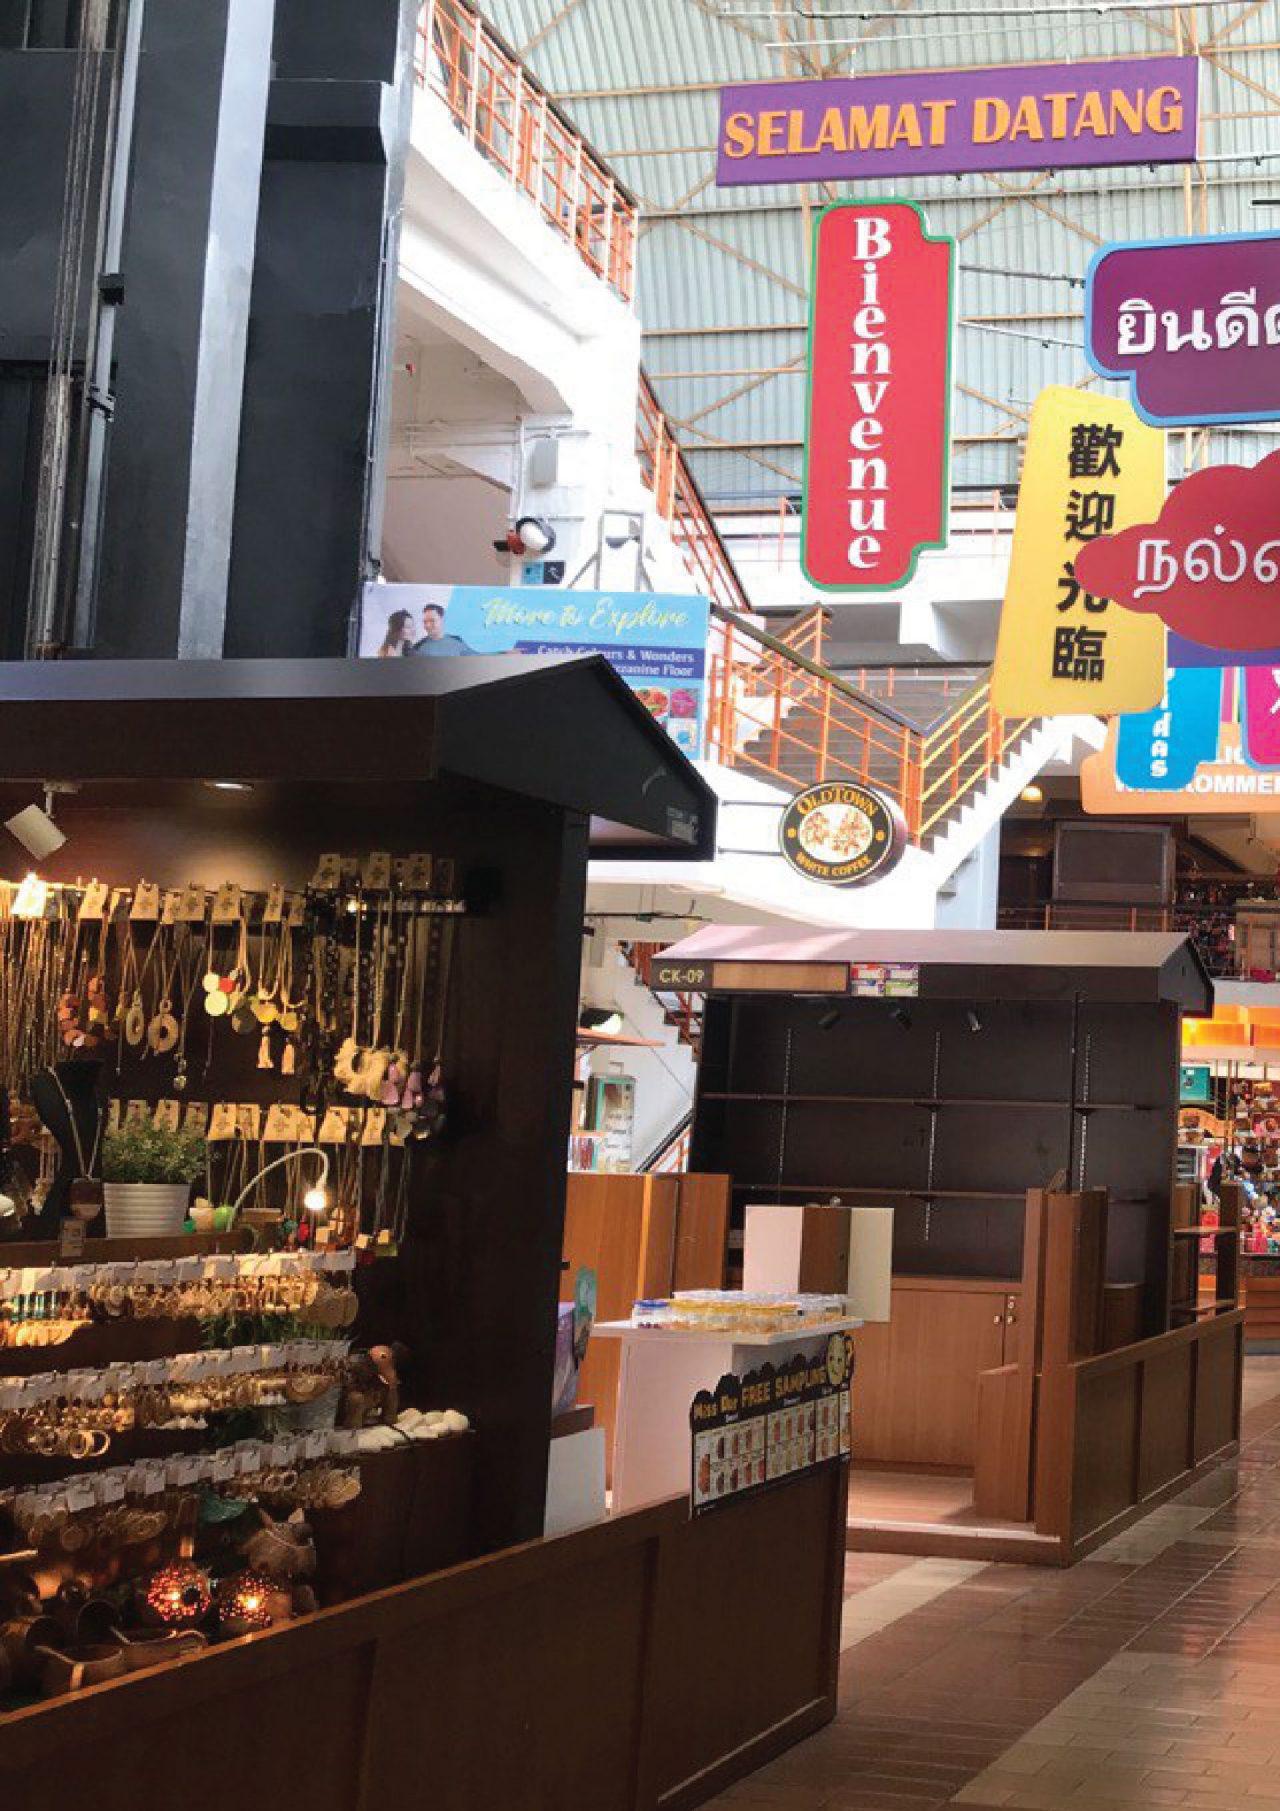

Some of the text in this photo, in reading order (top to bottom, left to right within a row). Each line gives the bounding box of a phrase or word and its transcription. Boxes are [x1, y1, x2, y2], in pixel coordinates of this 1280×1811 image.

[723, 86, 1184, 157] SELAMAT DATANG
[847, 217, 892, 569] Bienvenue
[659, 968, 705, 984] CK-09
